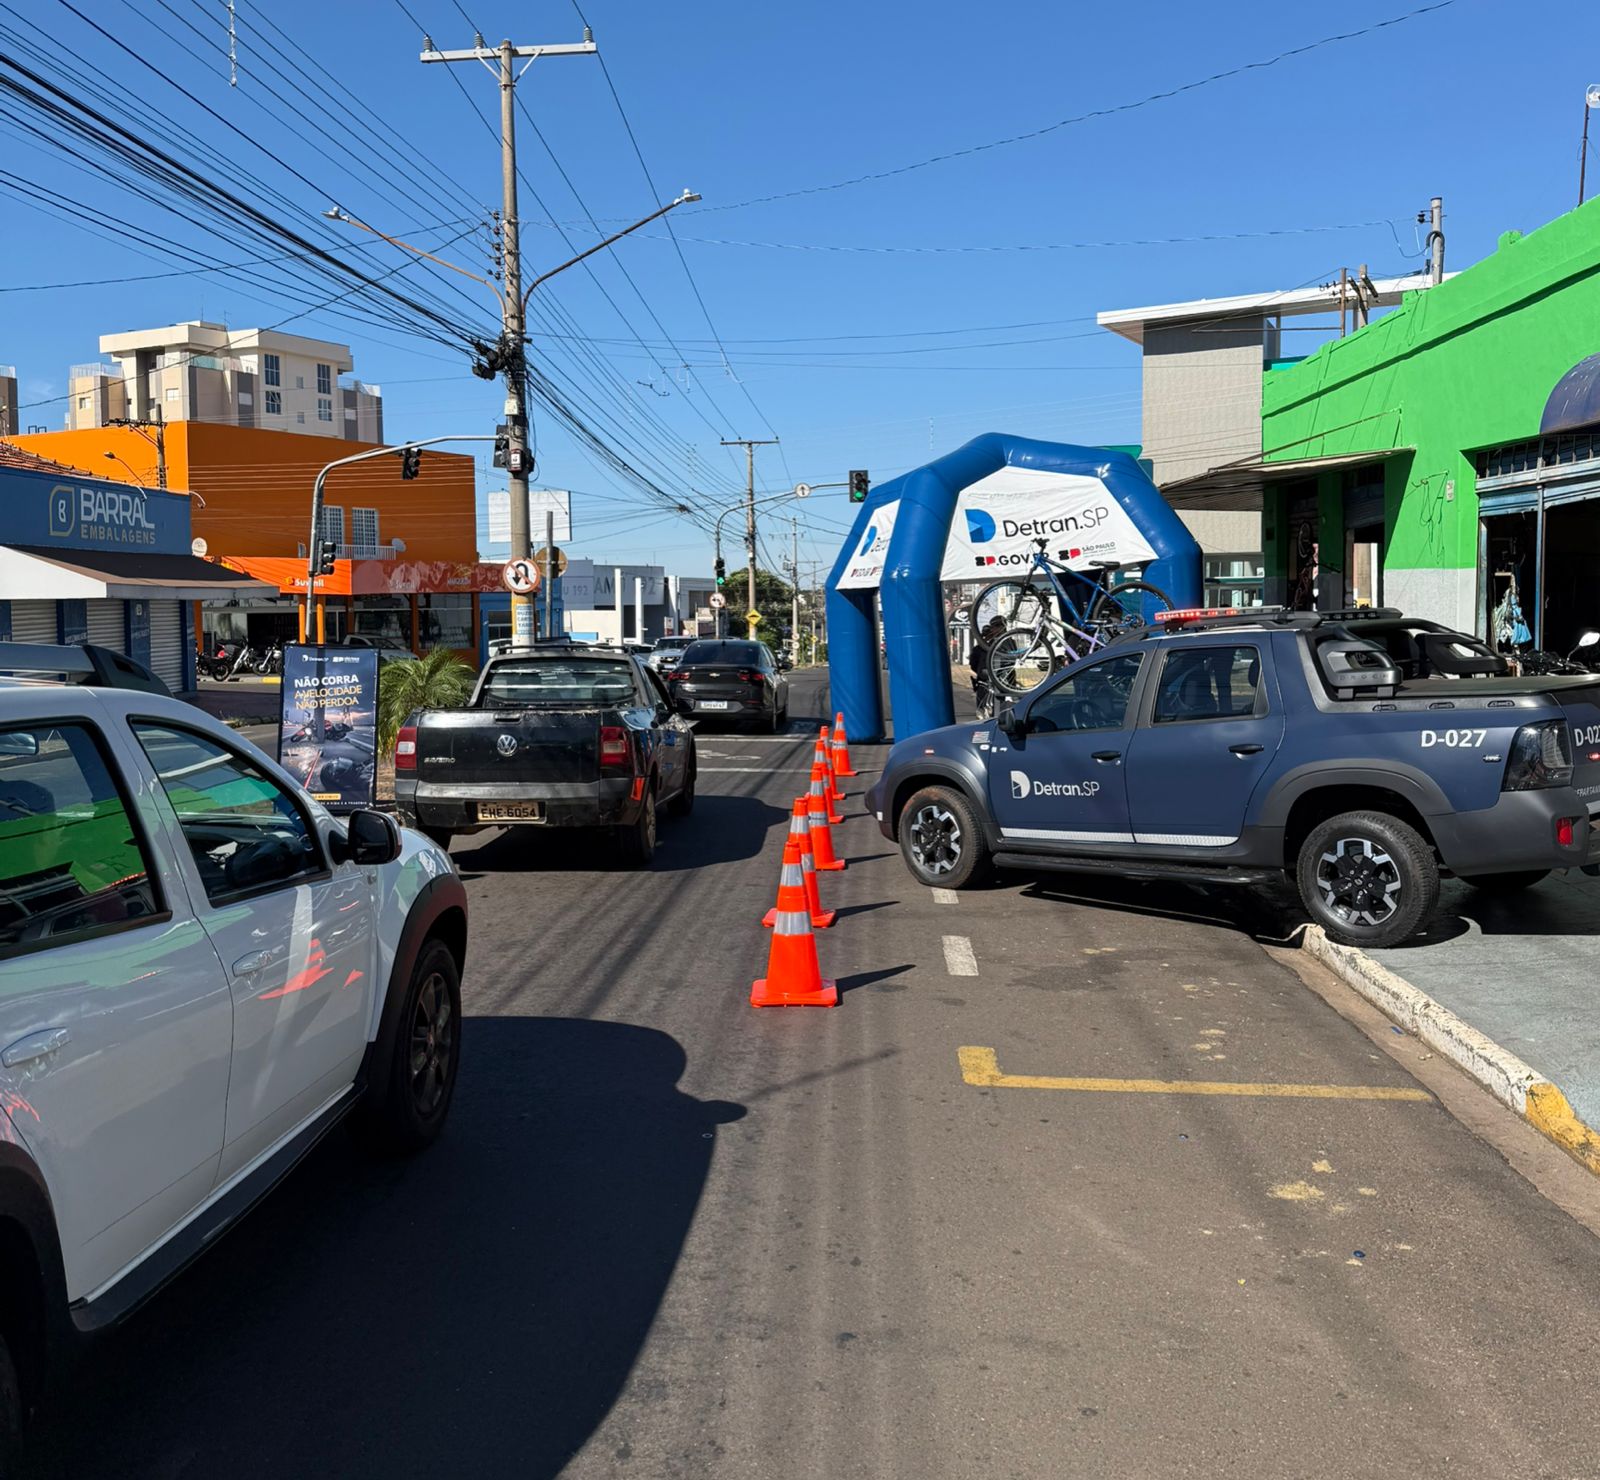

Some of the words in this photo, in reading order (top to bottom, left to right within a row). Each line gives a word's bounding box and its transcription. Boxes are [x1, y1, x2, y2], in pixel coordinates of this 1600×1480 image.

[80, 488, 155, 529] BARRAL
[1003, 507, 1109, 538] Detran.SP
[80, 524, 156, 545] EMBALAGENS
[294, 577, 324, 587] Suvnil
[294, 675, 320, 688] NÃO
[321, 674, 359, 686] CORRA
[302, 685, 363, 698] VELOCIDADE
[296, 698, 319, 710] NÃO
[320, 697, 359, 708] PERDOA
[1421, 729, 1487, 748] D-027
[1033, 781, 1100, 797] Detran.SP
[481, 807, 537, 818] EHE-6054
